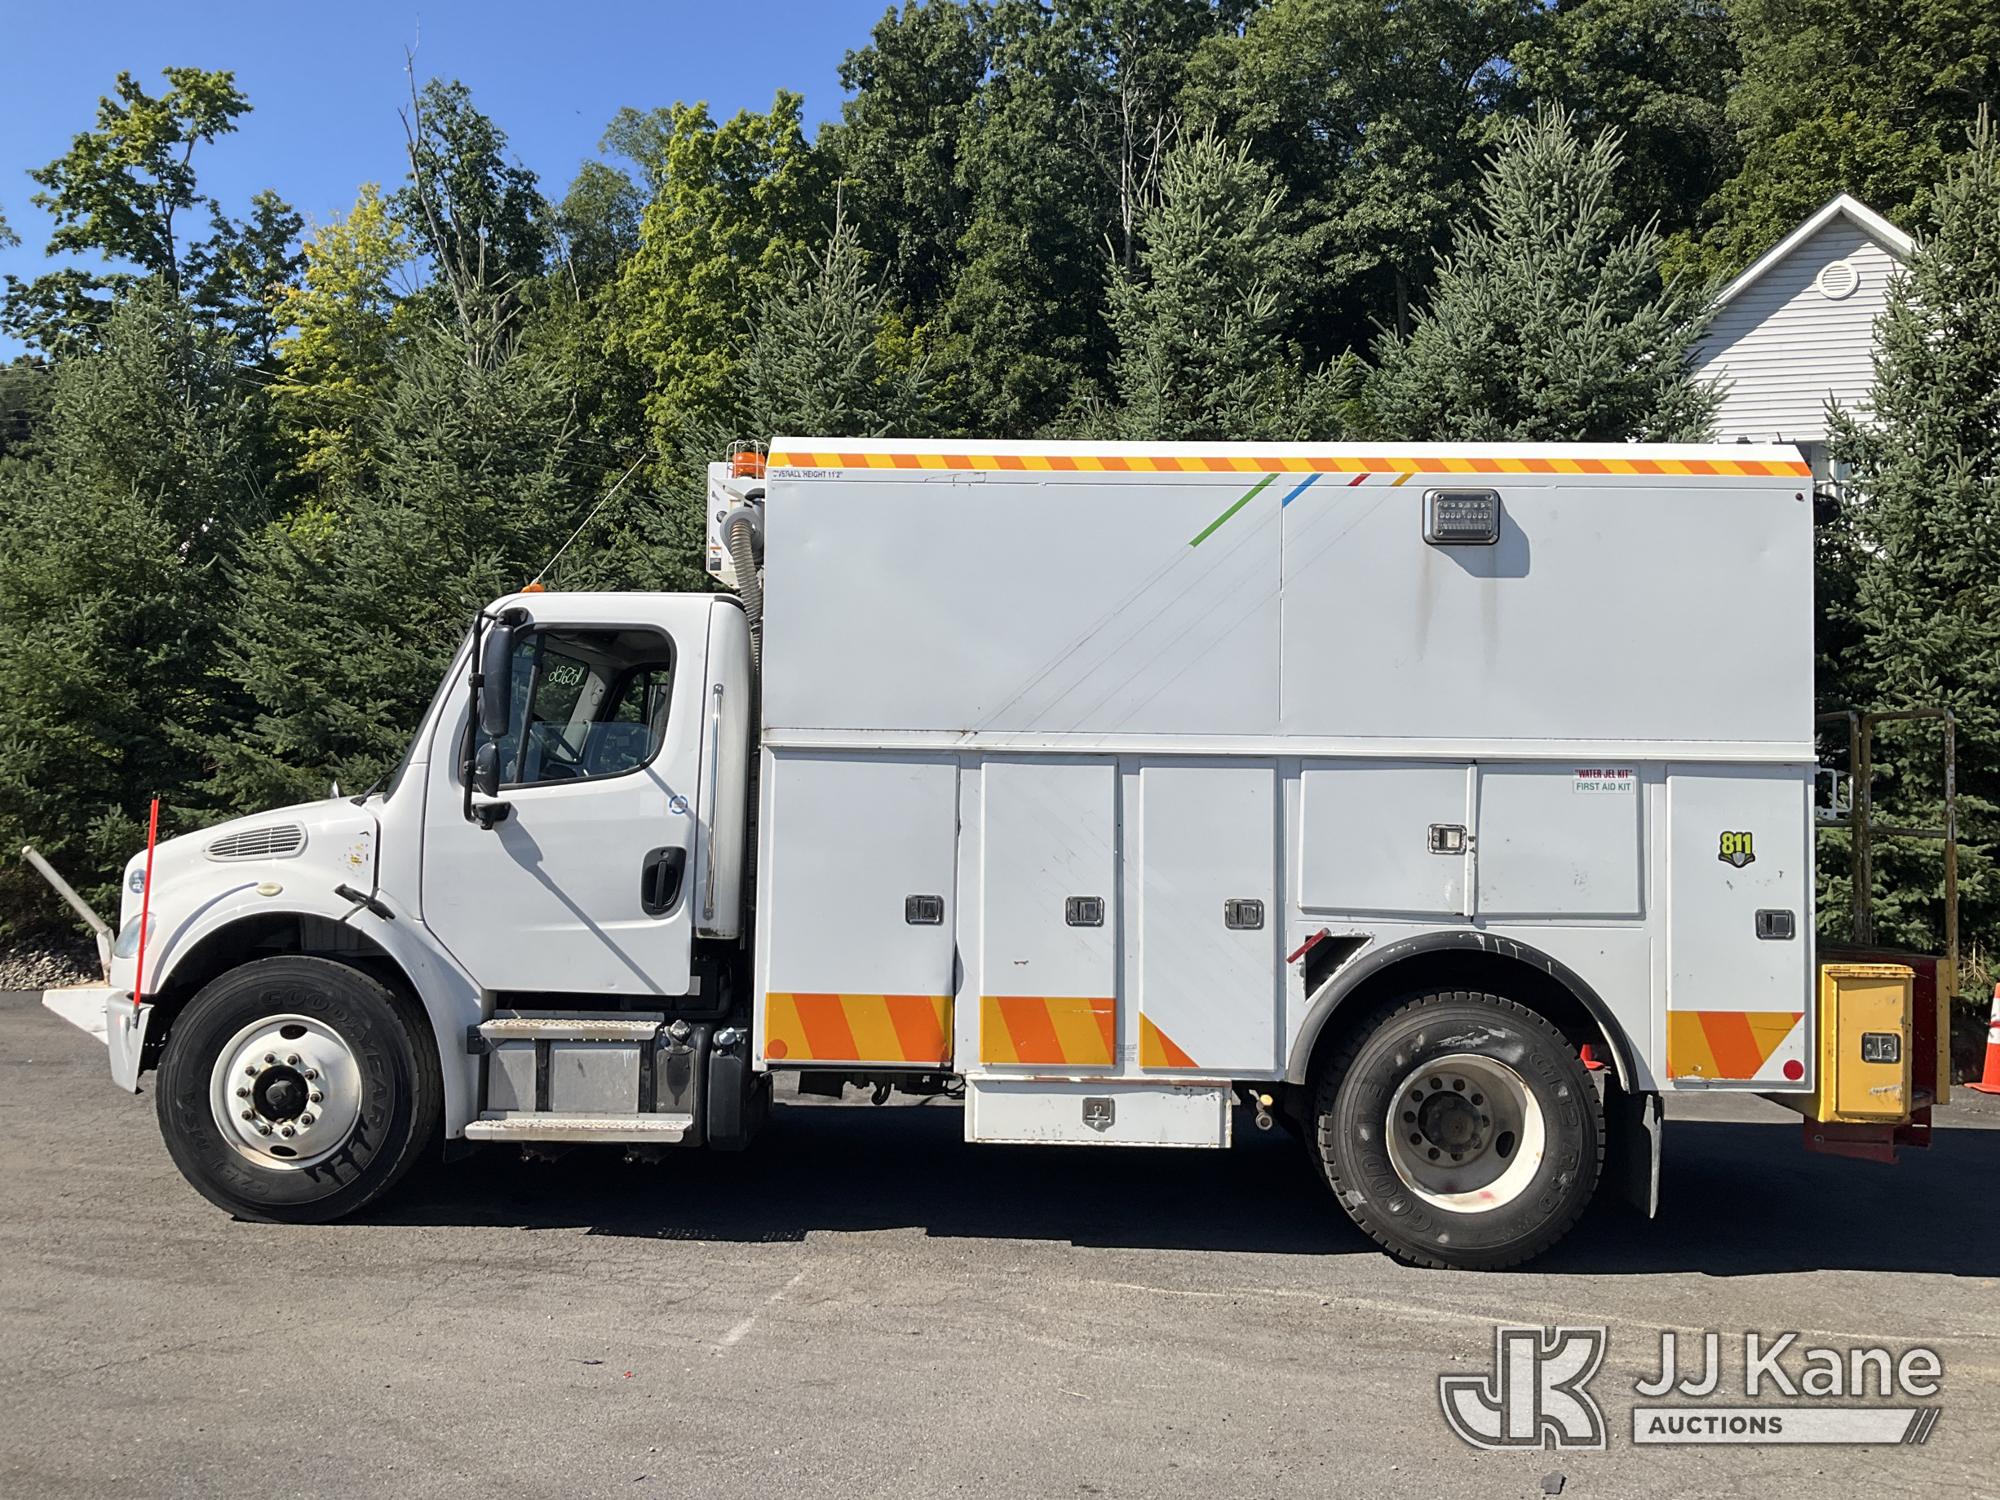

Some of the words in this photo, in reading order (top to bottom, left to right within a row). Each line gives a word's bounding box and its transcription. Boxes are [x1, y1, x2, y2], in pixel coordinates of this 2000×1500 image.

[803, 470, 826, 478] HEIGHT
[1603, 769, 1616, 778] JEL
[1576, 782, 1600, 791] FIRST
[1601, 782, 1616, 791] AID
[1617, 782, 1631, 791] KIT
[1720, 831, 1752, 855] 811
[259, 984, 388, 1131] GOODYEAR
